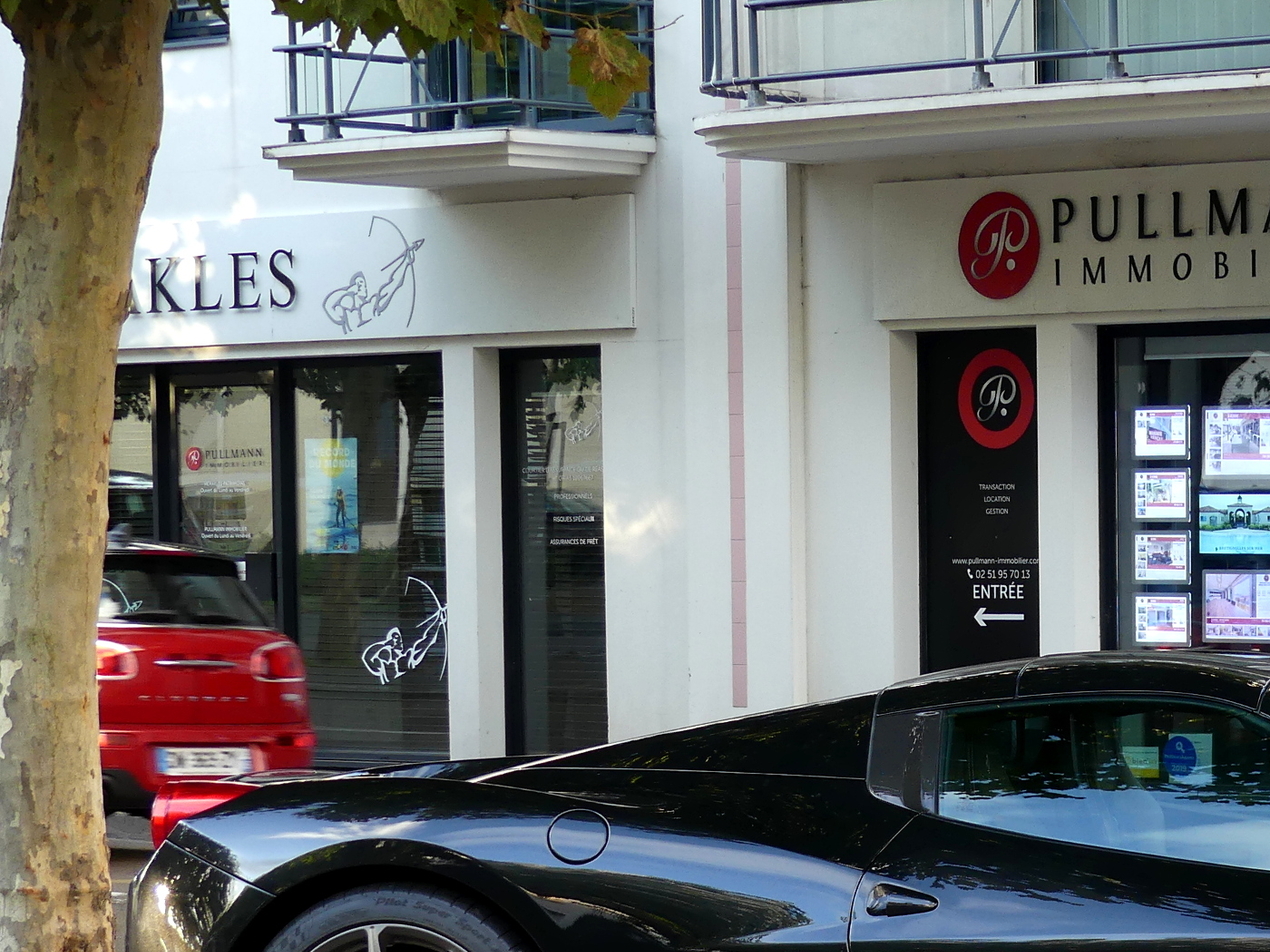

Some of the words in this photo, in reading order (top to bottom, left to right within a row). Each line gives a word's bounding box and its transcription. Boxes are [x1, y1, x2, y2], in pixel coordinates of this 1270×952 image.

[205, 448, 263, 460] PULLMANN
[325, 458, 356, 468] MONDE
[975, 570, 986, 579] 02
[987, 570, 997, 579] 51
[998, 570, 1008, 579] 95
[1009, 570, 1019, 579] 70
[1021, 570, 1031, 579] 13
[972, 581, 1025, 600] ENTRÉE
